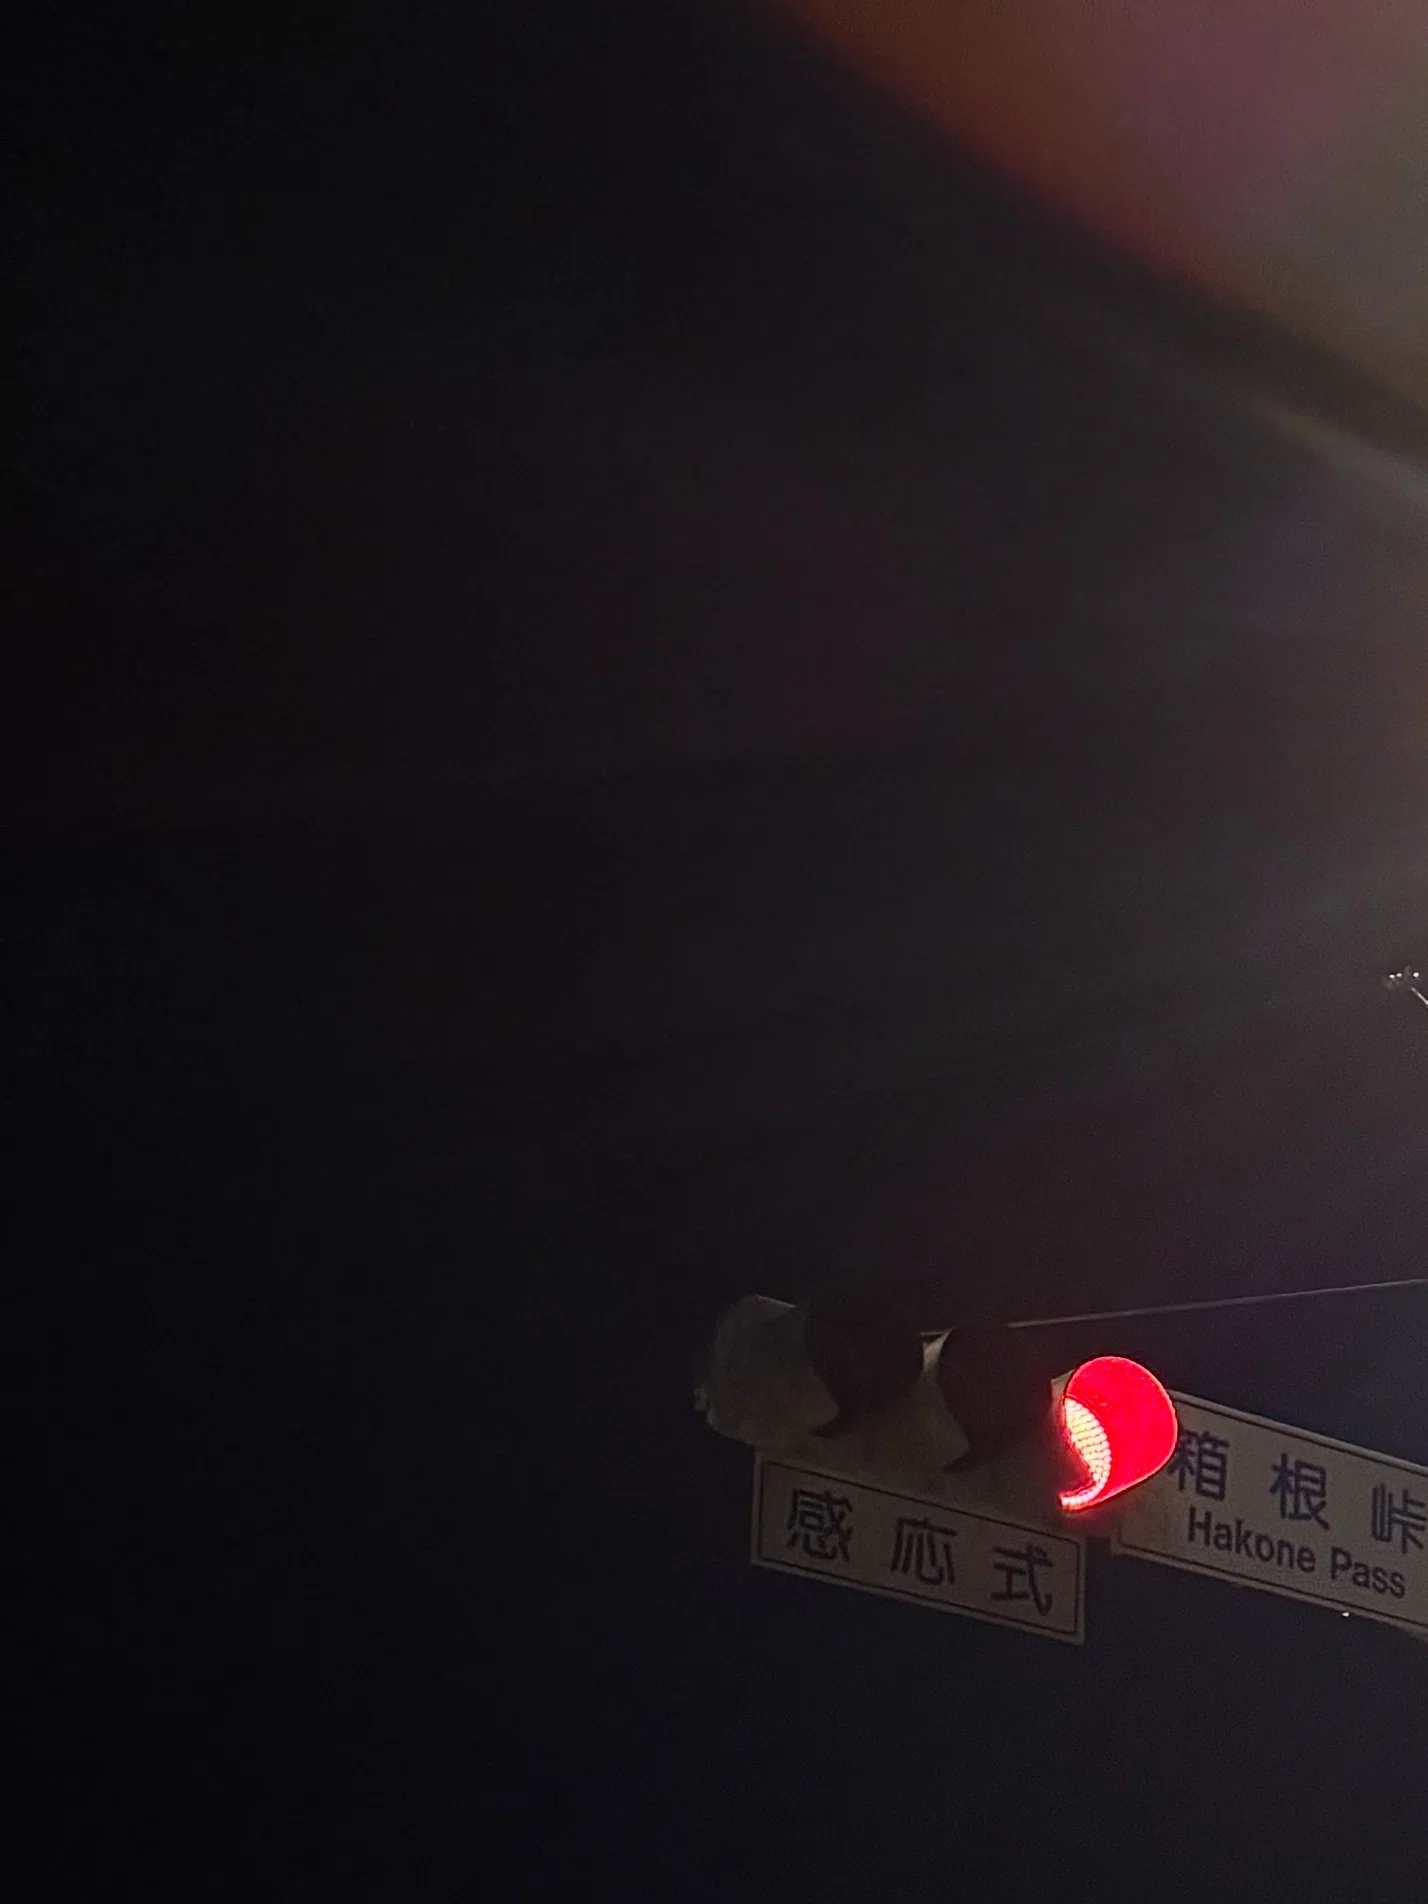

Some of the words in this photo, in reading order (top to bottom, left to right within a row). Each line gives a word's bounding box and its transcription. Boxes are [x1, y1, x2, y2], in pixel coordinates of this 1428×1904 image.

[785, 1487, 1055, 1618] 感応式
[1168, 1431, 1428, 1555] 箱根峠
[1187, 1505, 1315, 1574] Hakone
[1330, 1546, 1406, 1599] Pass
